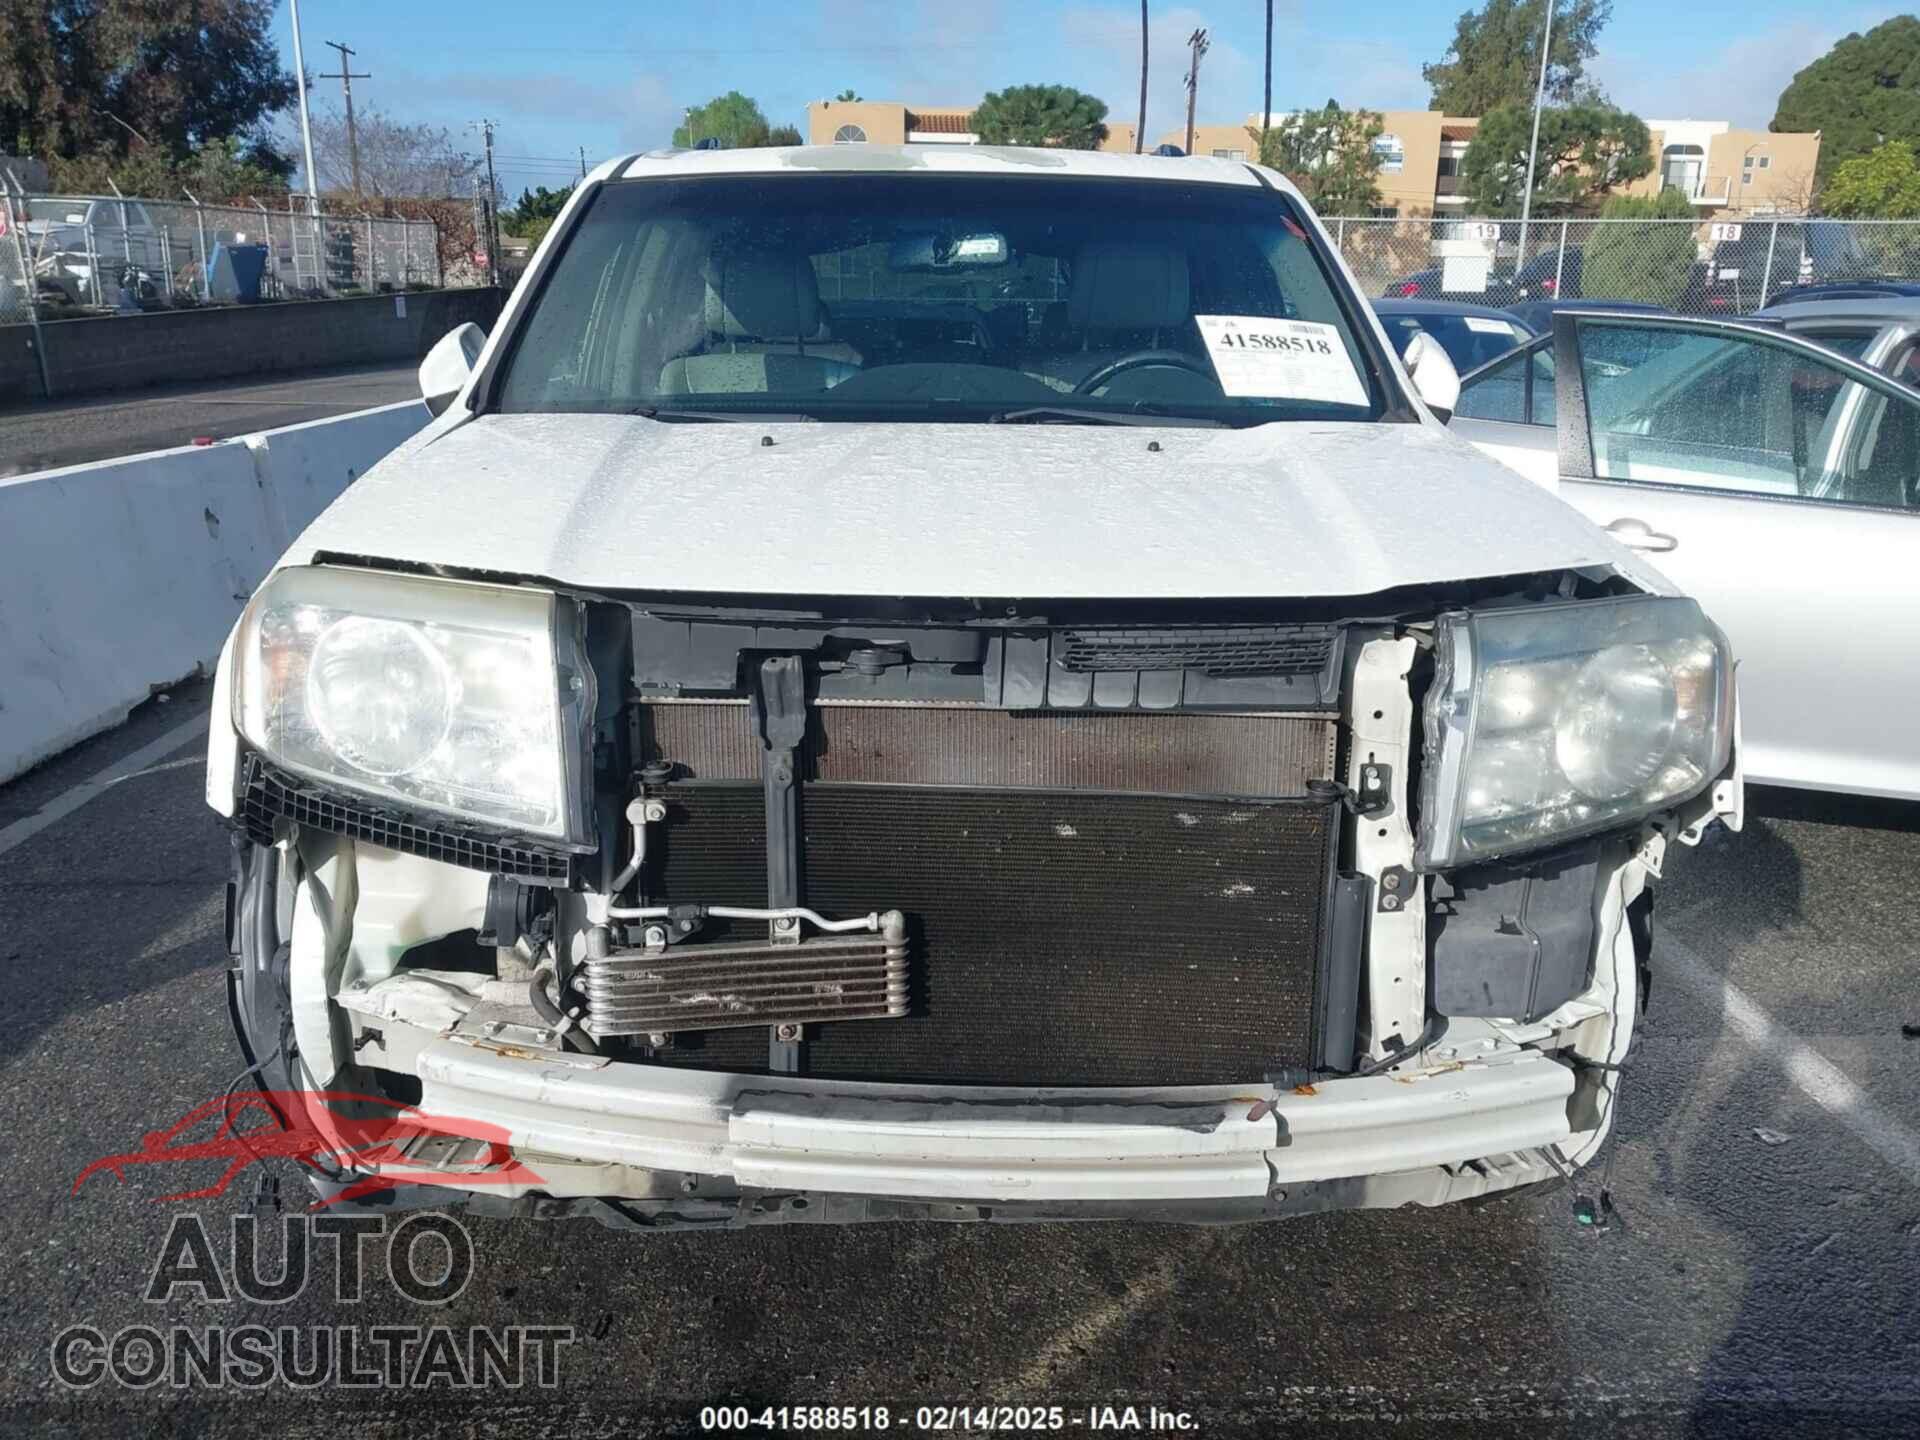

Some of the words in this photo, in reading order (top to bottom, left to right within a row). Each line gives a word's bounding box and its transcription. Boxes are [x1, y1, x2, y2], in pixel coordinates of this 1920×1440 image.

[1476, 224, 1496, 238] 19
[1717, 225, 1736, 239] 18
[1220, 332, 1331, 355] 41588518
